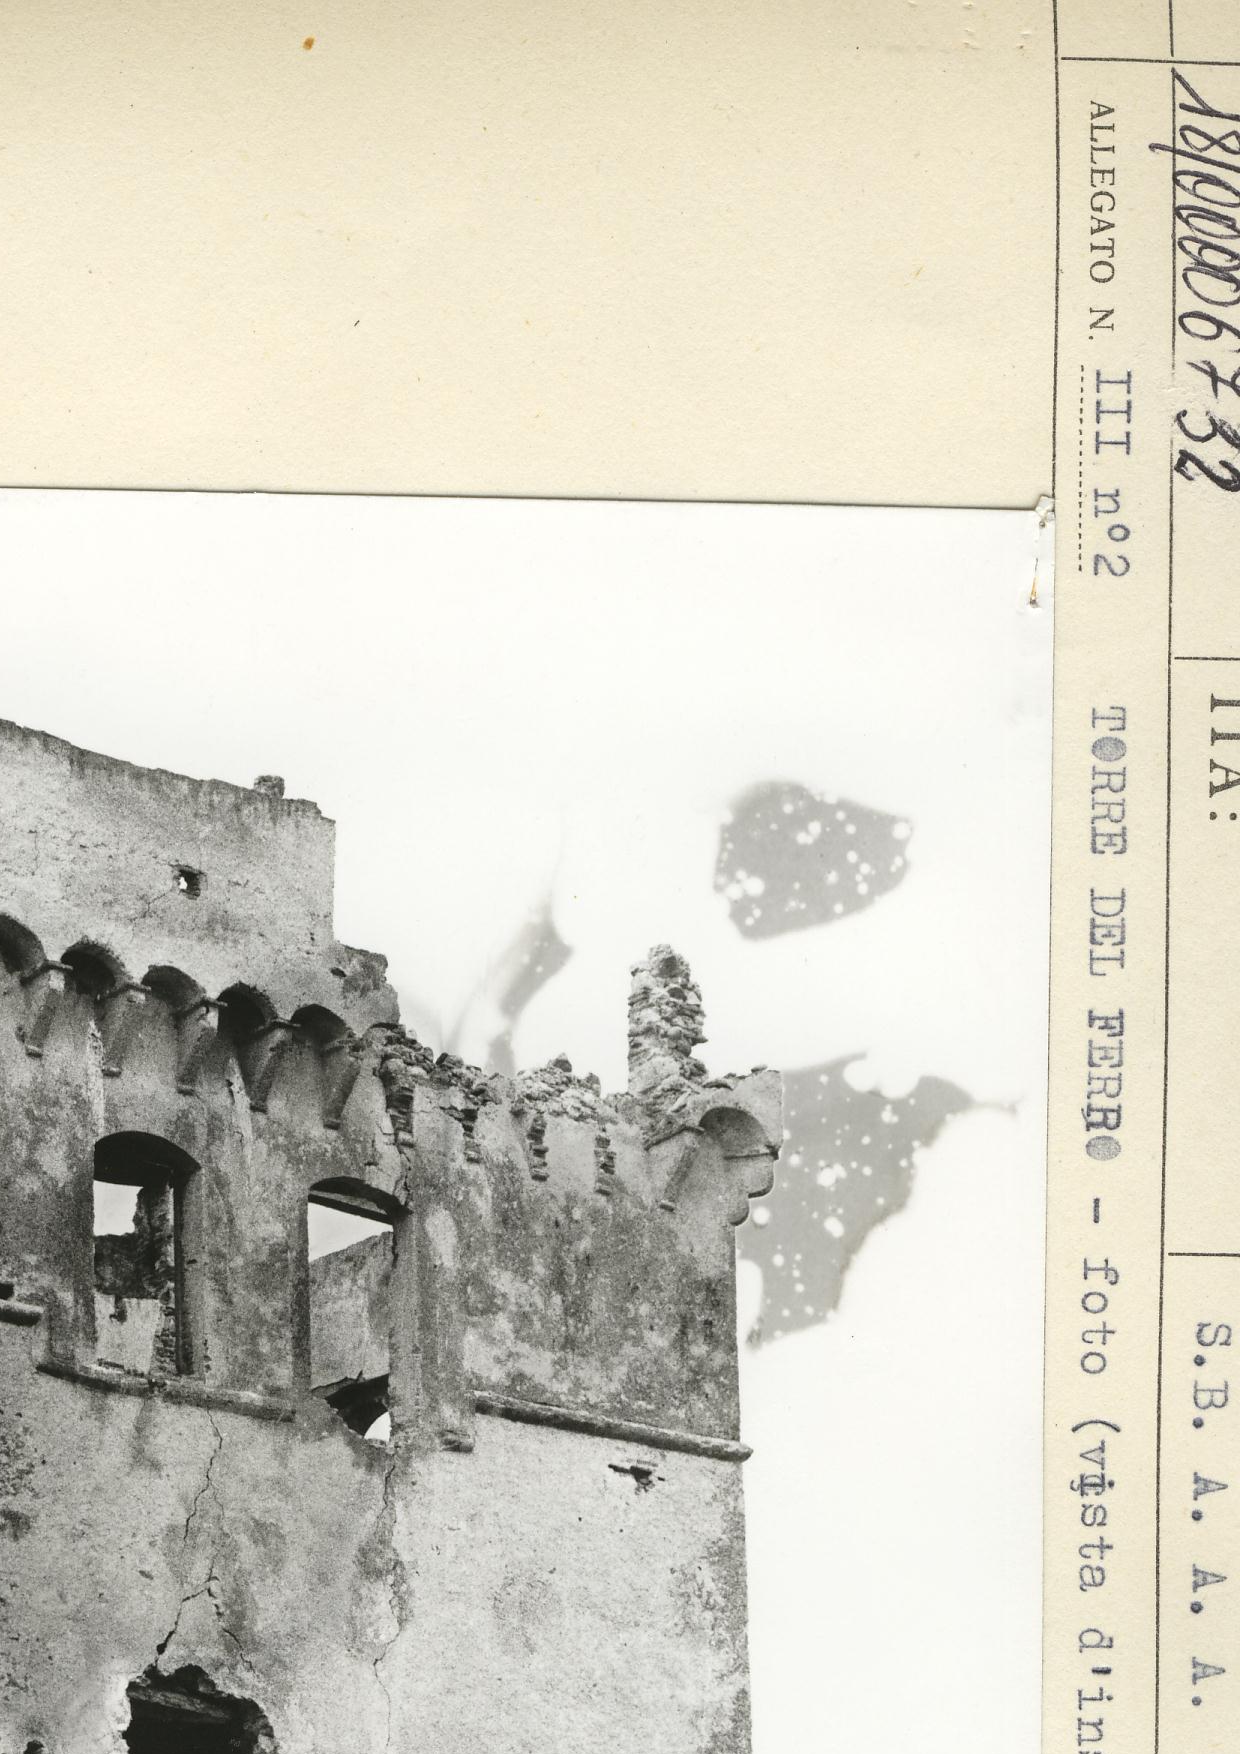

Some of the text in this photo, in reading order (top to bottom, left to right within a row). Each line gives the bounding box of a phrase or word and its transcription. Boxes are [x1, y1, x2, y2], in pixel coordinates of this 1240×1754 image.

[1089, 99, 1116, 284] ALLEGATO
[1088, 306, 1115, 341] N.
[1094, 368, 1133, 456] III
[1089, 705, 1128, 855] TORRE
[1087, 887, 1127, 977] DEL
[1081, 1007, 1125, 1161] FERRO
[1079, 1256, 1121, 1375] foto
[1069, 1418, 1122, 1593] (vista
